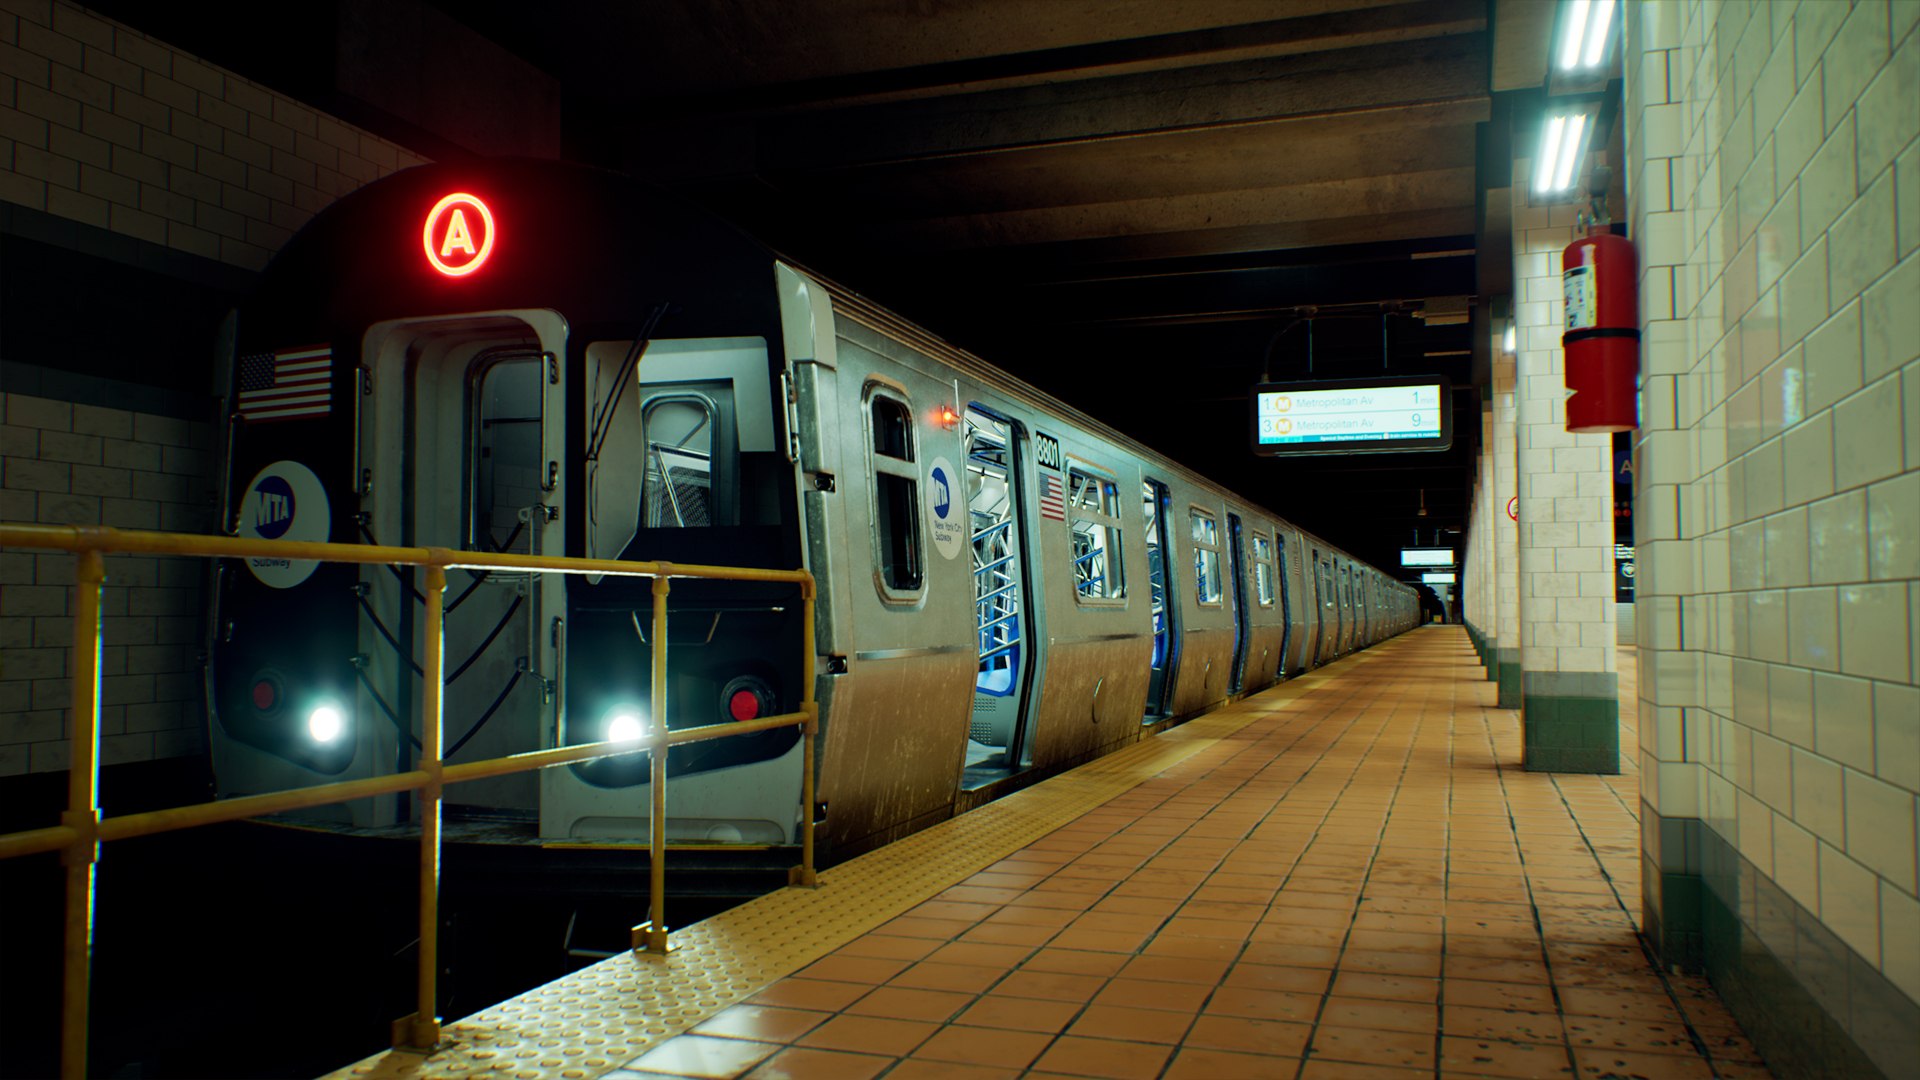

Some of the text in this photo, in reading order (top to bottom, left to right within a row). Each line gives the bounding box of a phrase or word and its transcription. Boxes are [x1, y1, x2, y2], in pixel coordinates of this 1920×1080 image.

[440, 208, 477, 257] A
[1296, 397, 1358, 409] Metropolitan
[1360, 395, 1374, 405] Av
[1412, 391, 1419, 404] 1
[1296, 419, 1359, 431] Metropolitan
[1360, 418, 1375, 427] Av
[1411, 413, 1421, 427] 9
[1036, 434, 1059, 468] 8801
[931, 475, 948, 508] MTA
[251, 490, 290, 528] MTA
[934, 520, 963, 535] New York City
[934, 532, 952, 544] Subway
[252, 558, 291, 569] Subway
